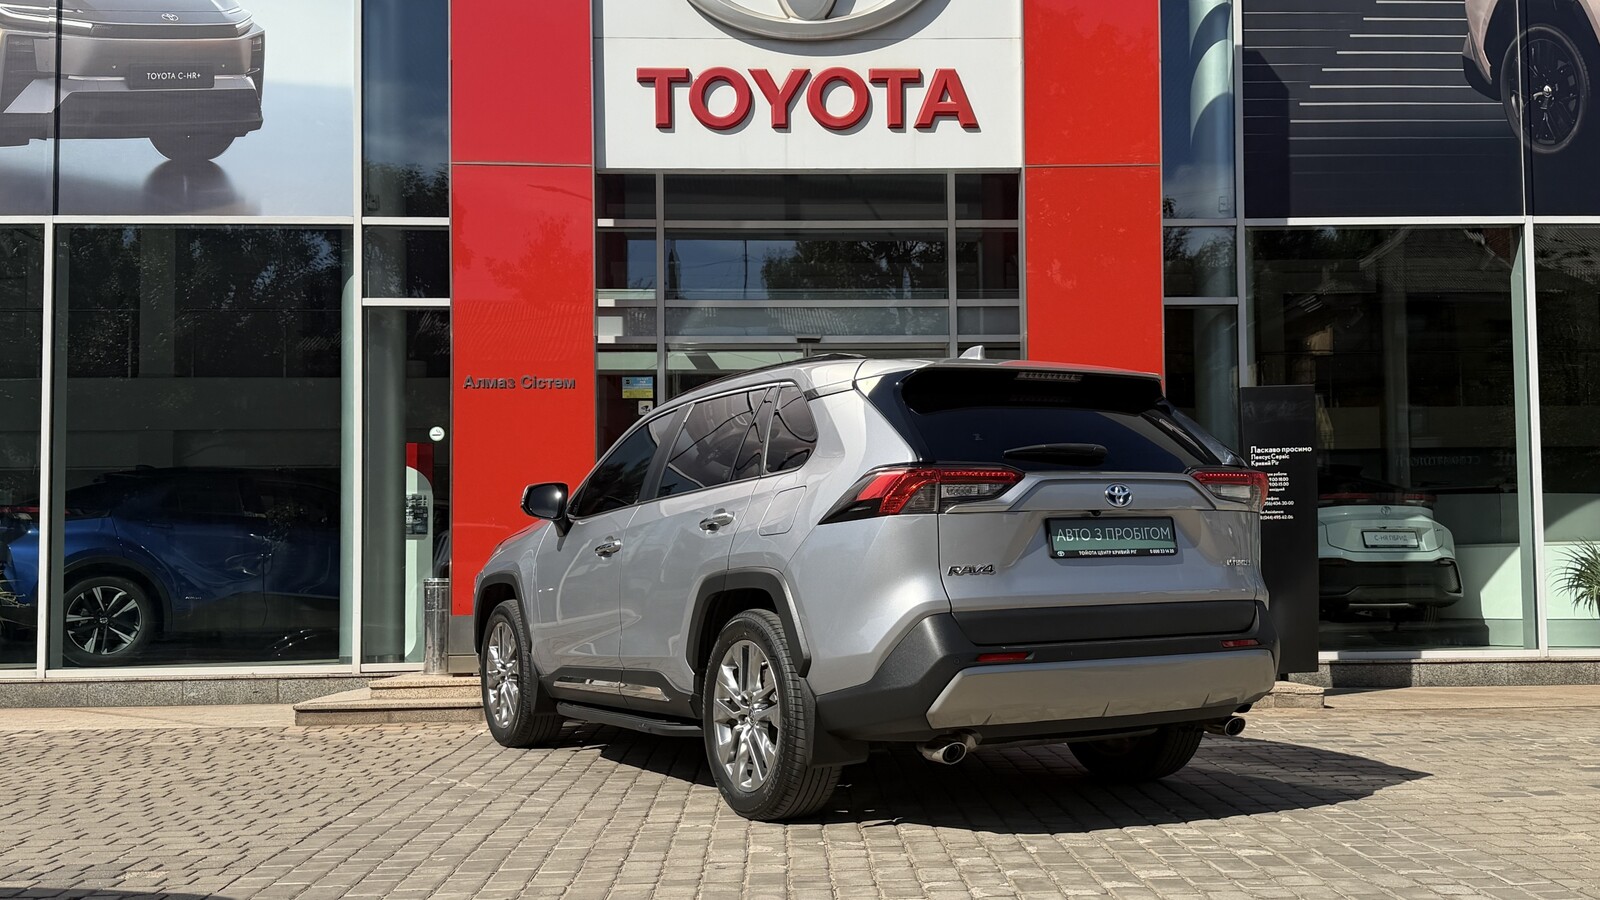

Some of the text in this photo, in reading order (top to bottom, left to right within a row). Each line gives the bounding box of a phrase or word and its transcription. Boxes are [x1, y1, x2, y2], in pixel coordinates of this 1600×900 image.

[146, 72, 201, 80] TOYOTA C-HR+
[636, 67, 981, 130] TOYOTA
[463, 374, 576, 389] Алмаз Сістем
[1250, 445, 1281, 454] Ласкаво
[1056, 528, 1091, 542] АВТО
[1105, 527, 1171, 541] ПРОБІГОМ
[947, 564, 996, 577] RAV4
